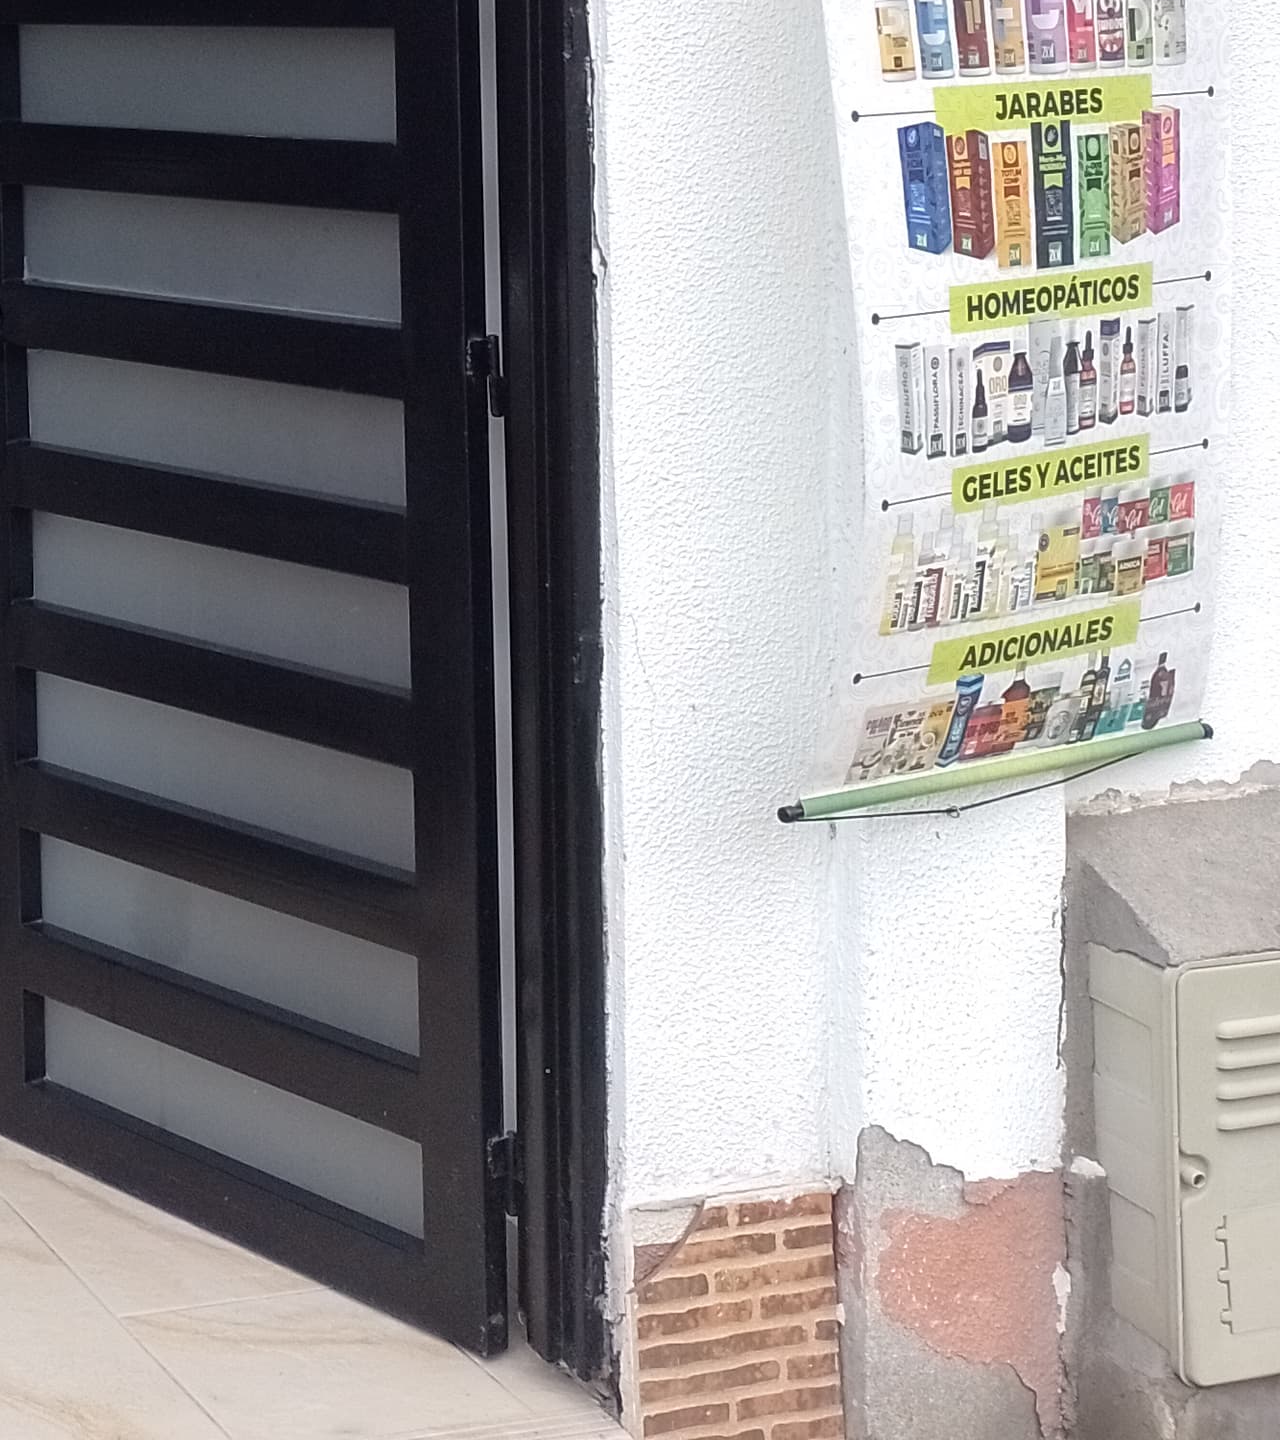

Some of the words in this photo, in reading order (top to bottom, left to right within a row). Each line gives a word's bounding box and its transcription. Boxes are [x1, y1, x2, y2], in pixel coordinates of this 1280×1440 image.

[994, 88, 1104, 121] JARABES
[966, 274, 1140, 322] HOMEOPÁTICOS
[962, 465, 1033, 503] GELES
[1037, 463, 1050, 490] Y
[1053, 445, 1141, 487] ACEITES
[959, 616, 1114, 671] ADICIONALES
